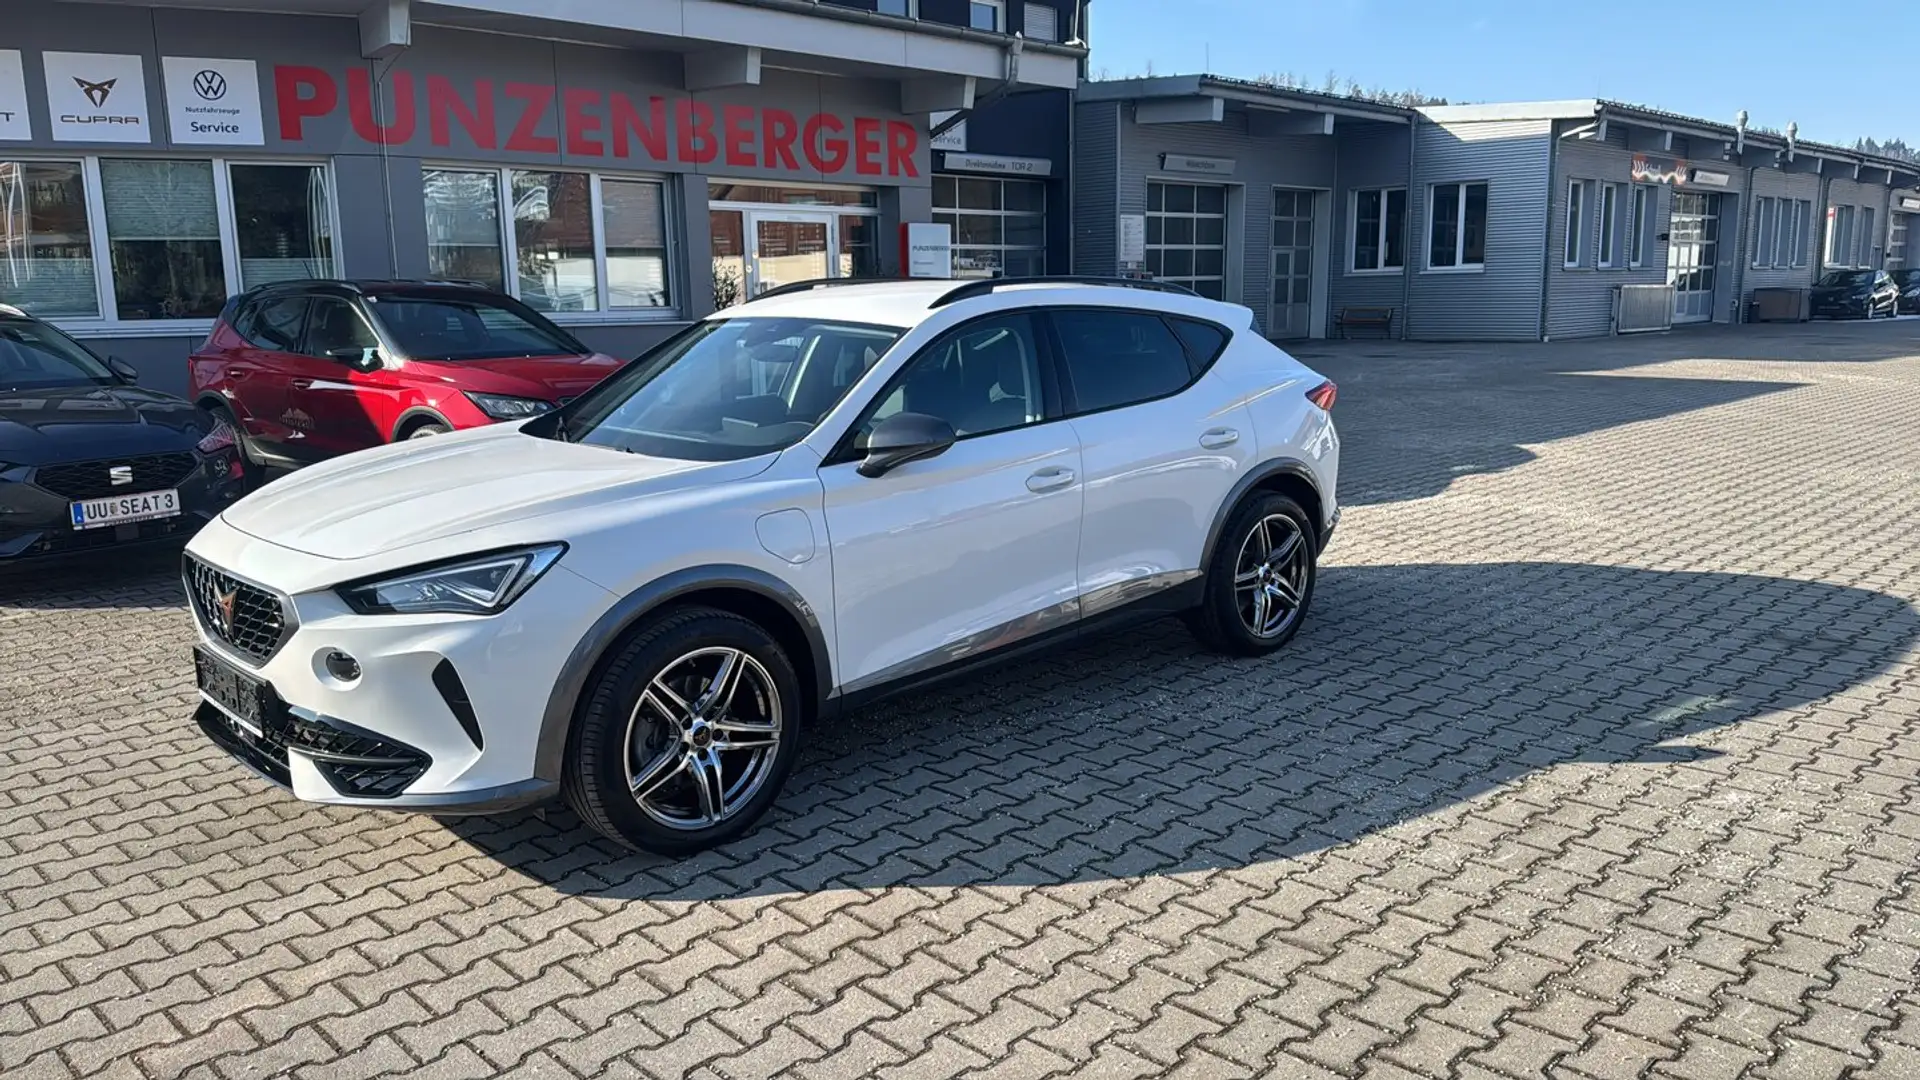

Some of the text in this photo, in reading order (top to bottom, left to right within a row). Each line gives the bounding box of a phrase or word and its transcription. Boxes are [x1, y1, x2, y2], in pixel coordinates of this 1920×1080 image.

[185, 106, 241, 115] Nutzfahrzeuge
[60, 114, 140, 125] CUPRA
[274, 65, 919, 178] PUNZENBERGER
[190, 121, 240, 134] Service
[86, 503, 107, 519] UU
[120, 495, 160, 515] SEAT
[164, 493, 174, 509] 3
